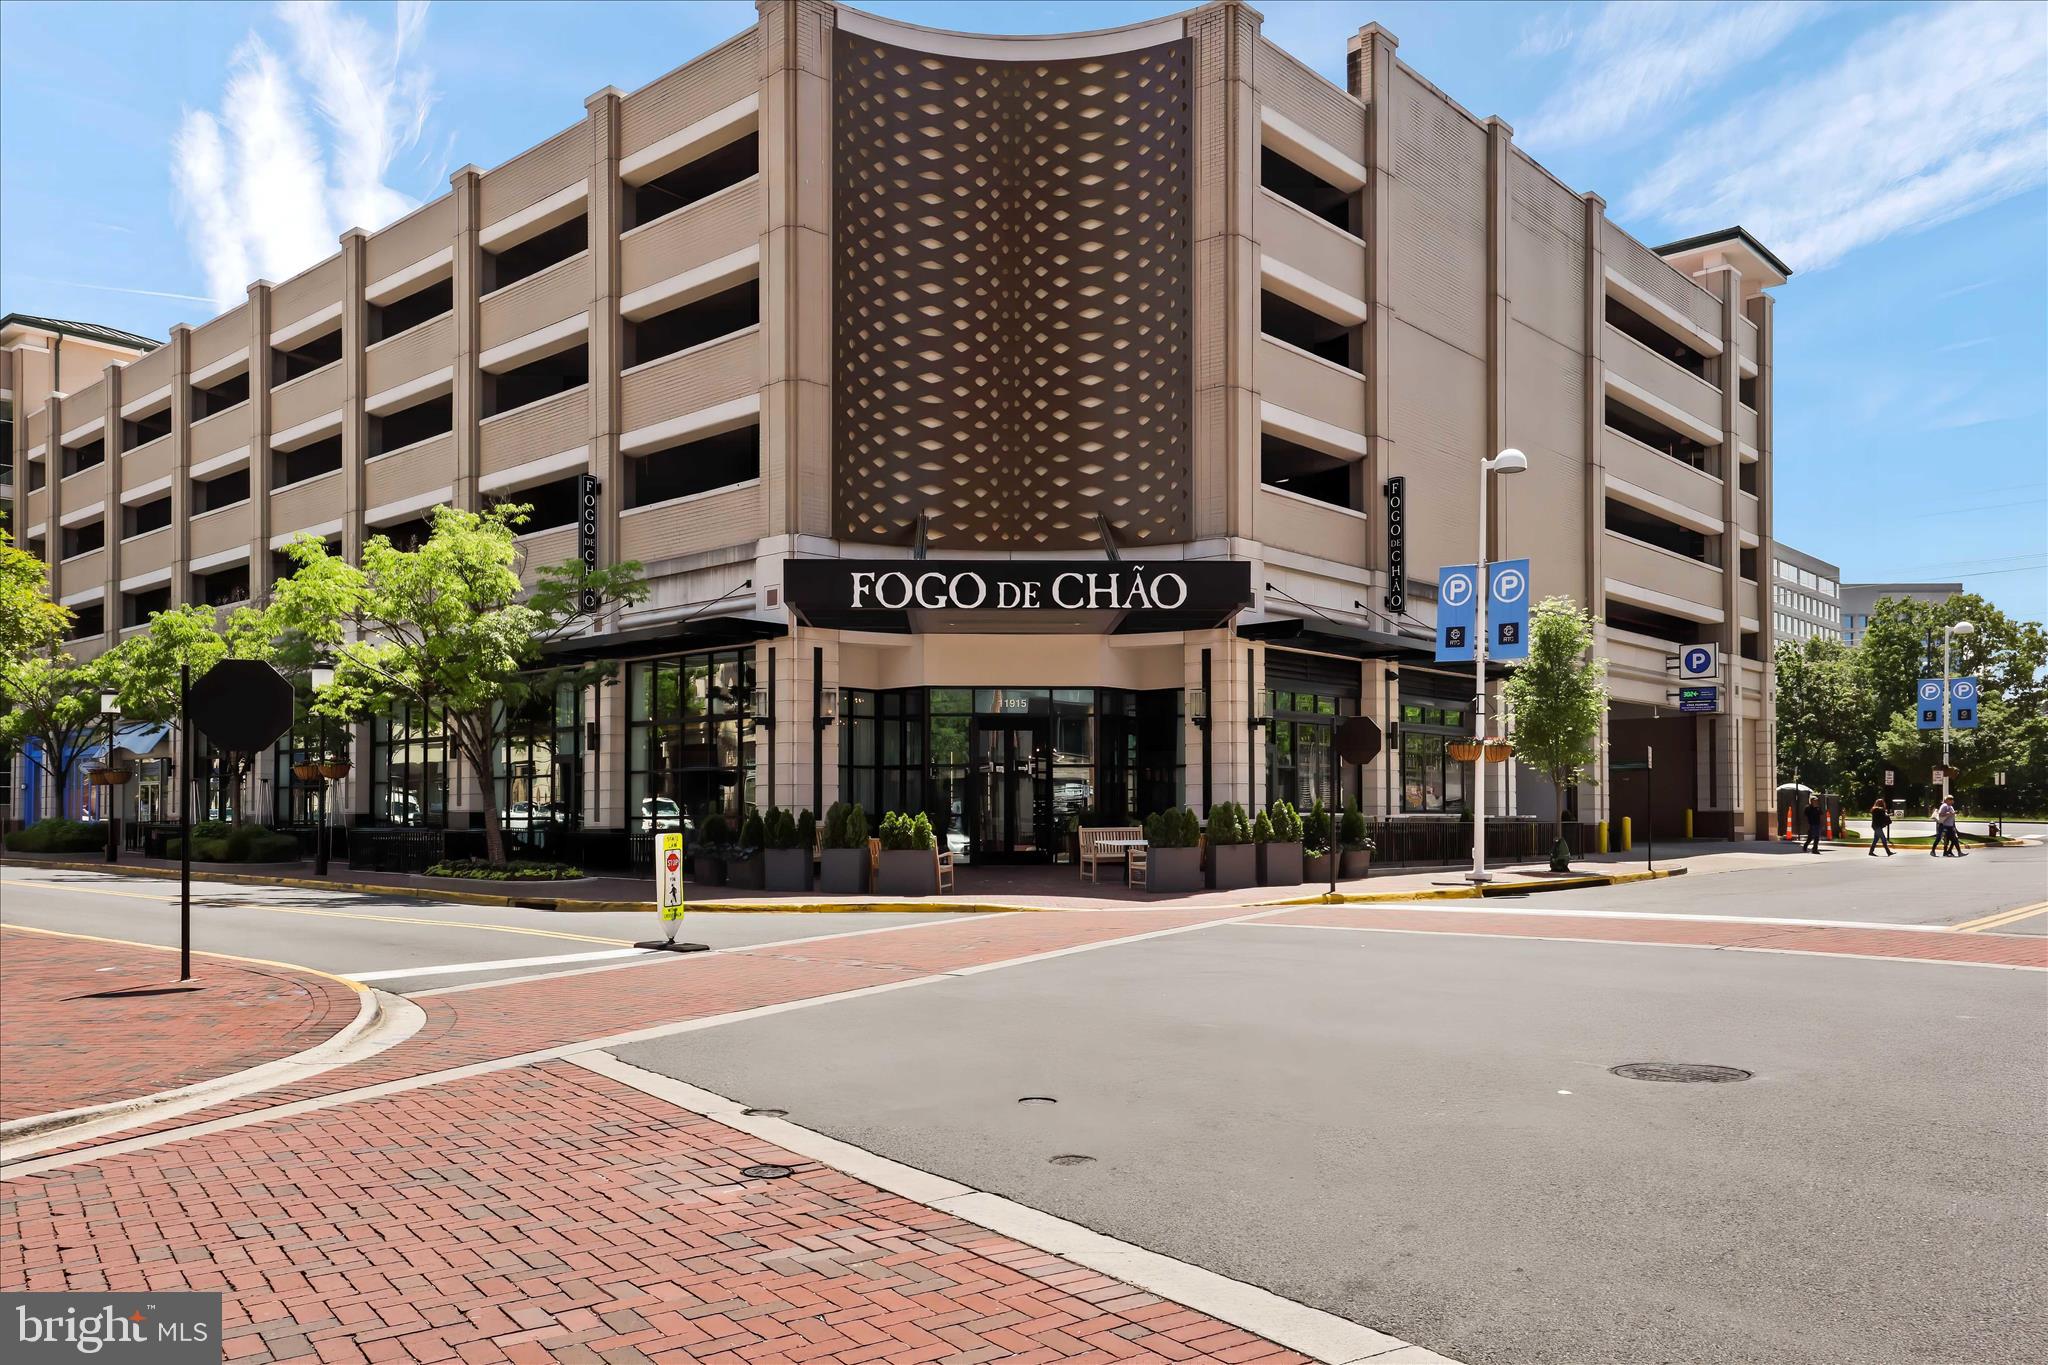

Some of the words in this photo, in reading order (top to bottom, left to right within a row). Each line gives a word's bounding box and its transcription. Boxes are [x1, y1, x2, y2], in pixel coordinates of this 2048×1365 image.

[584, 480, 595, 535] FOGO
[1390, 483, 1401, 536] FOGO
[584, 537, 595, 547] DE
[1390, 539, 1401, 548] DE
[584, 549, 595, 607] CHO
[1391, 550, 1402, 607] CHÃO
[1501, 576, 1519, 597] P
[850, 571, 987, 610] FOGO
[997, 581, 1041, 608] DE
[1052, 565, 1188, 610] CHÃO
[1450, 580, 1466, 601] P
[1692, 653, 1706, 669] P
[1925, 686, 1937, 697] P
[1958, 685, 1970, 696] P
[999, 699, 1027, 708] 11915
[667, 859, 679, 867] STOP
